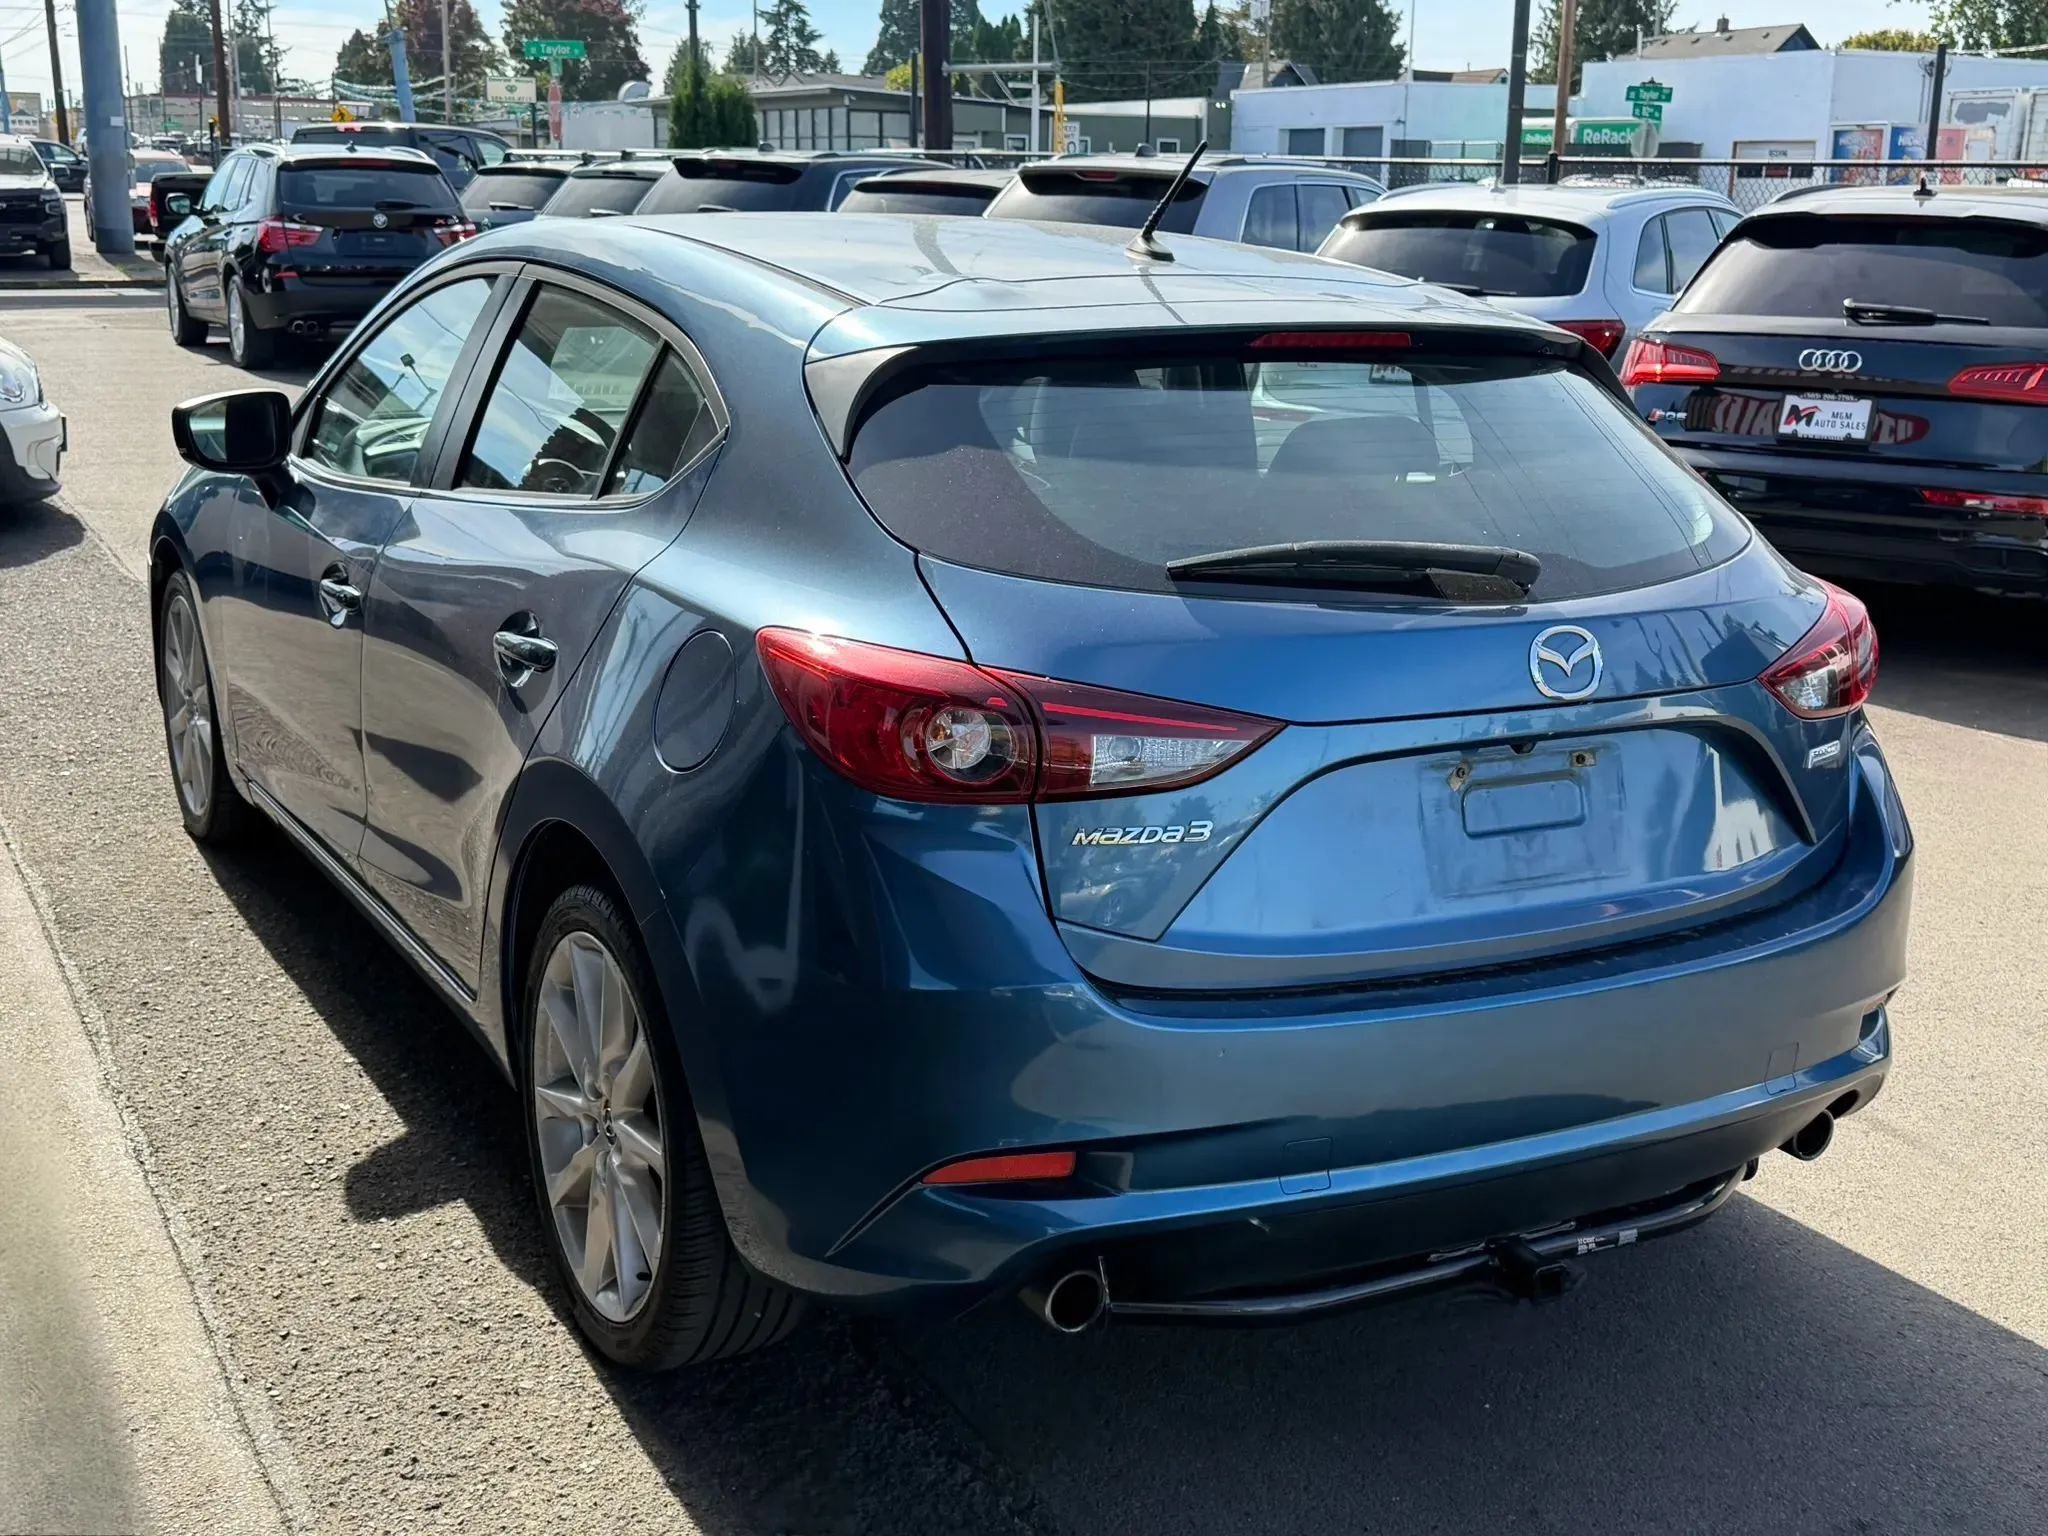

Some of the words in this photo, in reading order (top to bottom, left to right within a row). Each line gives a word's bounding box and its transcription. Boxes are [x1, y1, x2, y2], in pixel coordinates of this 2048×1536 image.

[540, 44, 571, 57] Taylor
[1831, 411, 1853, 420] M&M
[1814, 419, 1837, 429] AUTO
[1840, 422, 1866, 431] SALES
